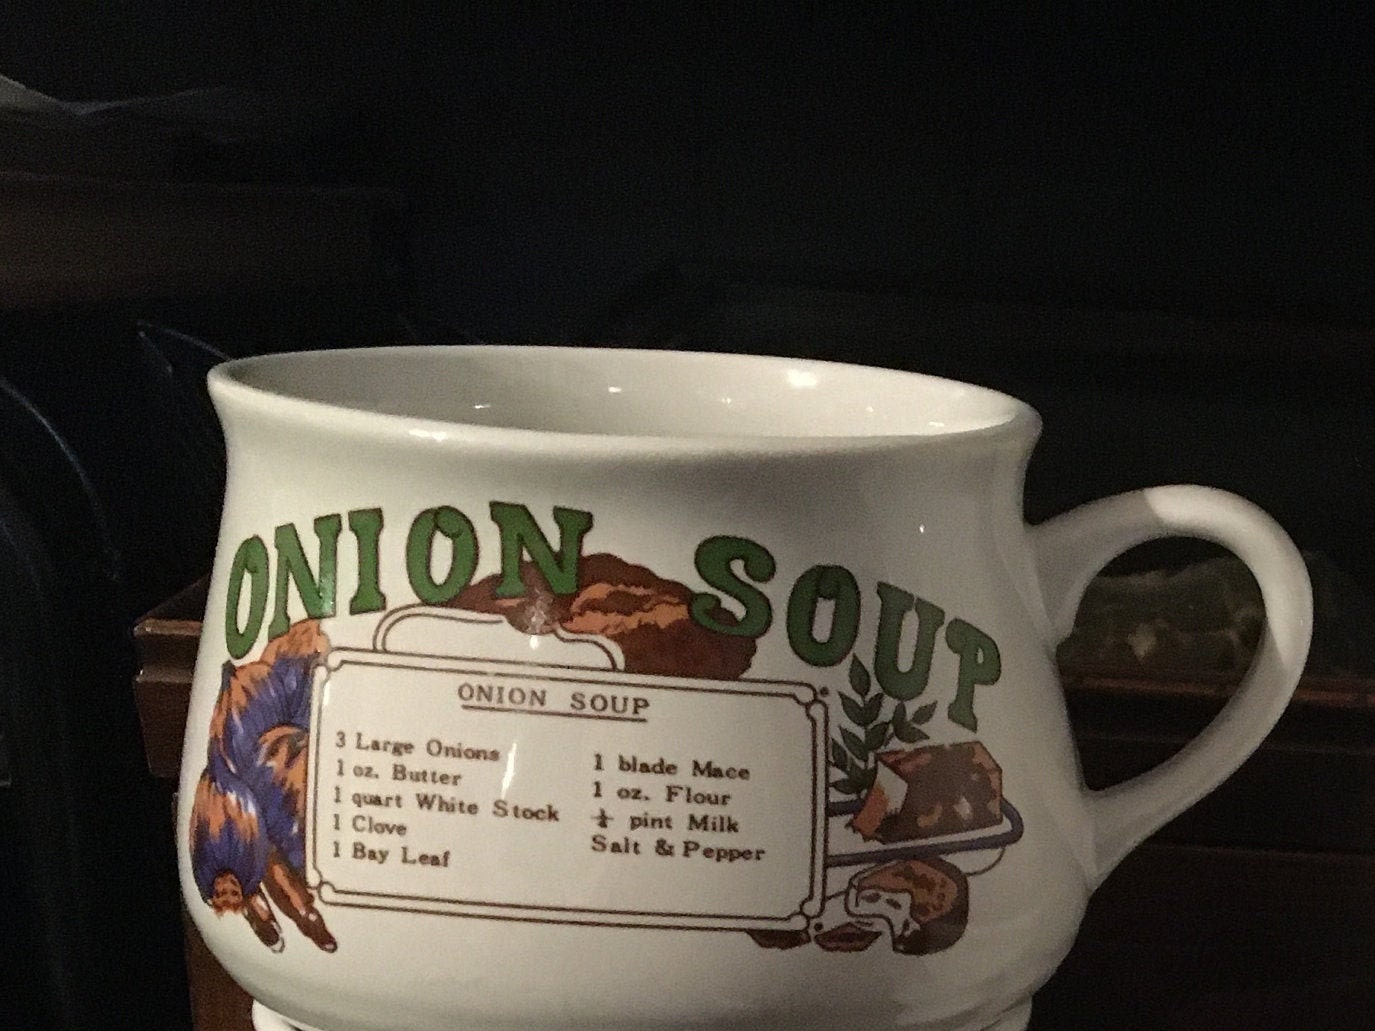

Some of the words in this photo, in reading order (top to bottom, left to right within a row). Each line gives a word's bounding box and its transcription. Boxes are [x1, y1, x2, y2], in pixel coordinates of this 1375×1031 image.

[224, 500, 594, 660] ONION
[689, 534, 1002, 732] SOUP
[457, 683, 547, 707] ONION
[570, 692, 651, 715] SOUP
[335, 732, 345, 748] 3
[356, 733, 414, 756] Large
[427, 740, 500, 761] Onions
[336, 760, 344, 776] 1
[353, 765, 380, 779] oz.
[392, 765, 462, 786] Butter
[594, 755, 604, 771] 1
[618, 756, 678, 776] blade
[692, 760, 750, 780] Mace
[334, 786, 341, 803] 1
[351, 791, 403, 810] quart
[416, 793, 479, 815] White
[492, 800, 559, 822] Stock
[594, 782, 603, 798] 1
[617, 787, 650, 801] oz.
[666, 787, 731, 806] Flour
[333, 814, 341, 830] 1
[351, 816, 408, 836] Clove
[630, 814, 673, 831] pint
[688, 815, 740, 833] Milk
[333, 841, 341, 857] 1
[351, 843, 389, 865] Bay
[401, 848, 450, 867] Leaf
[592, 836, 641, 855] Salt
[655, 840, 675, 857] &
[683, 841, 766, 863] Pepper
